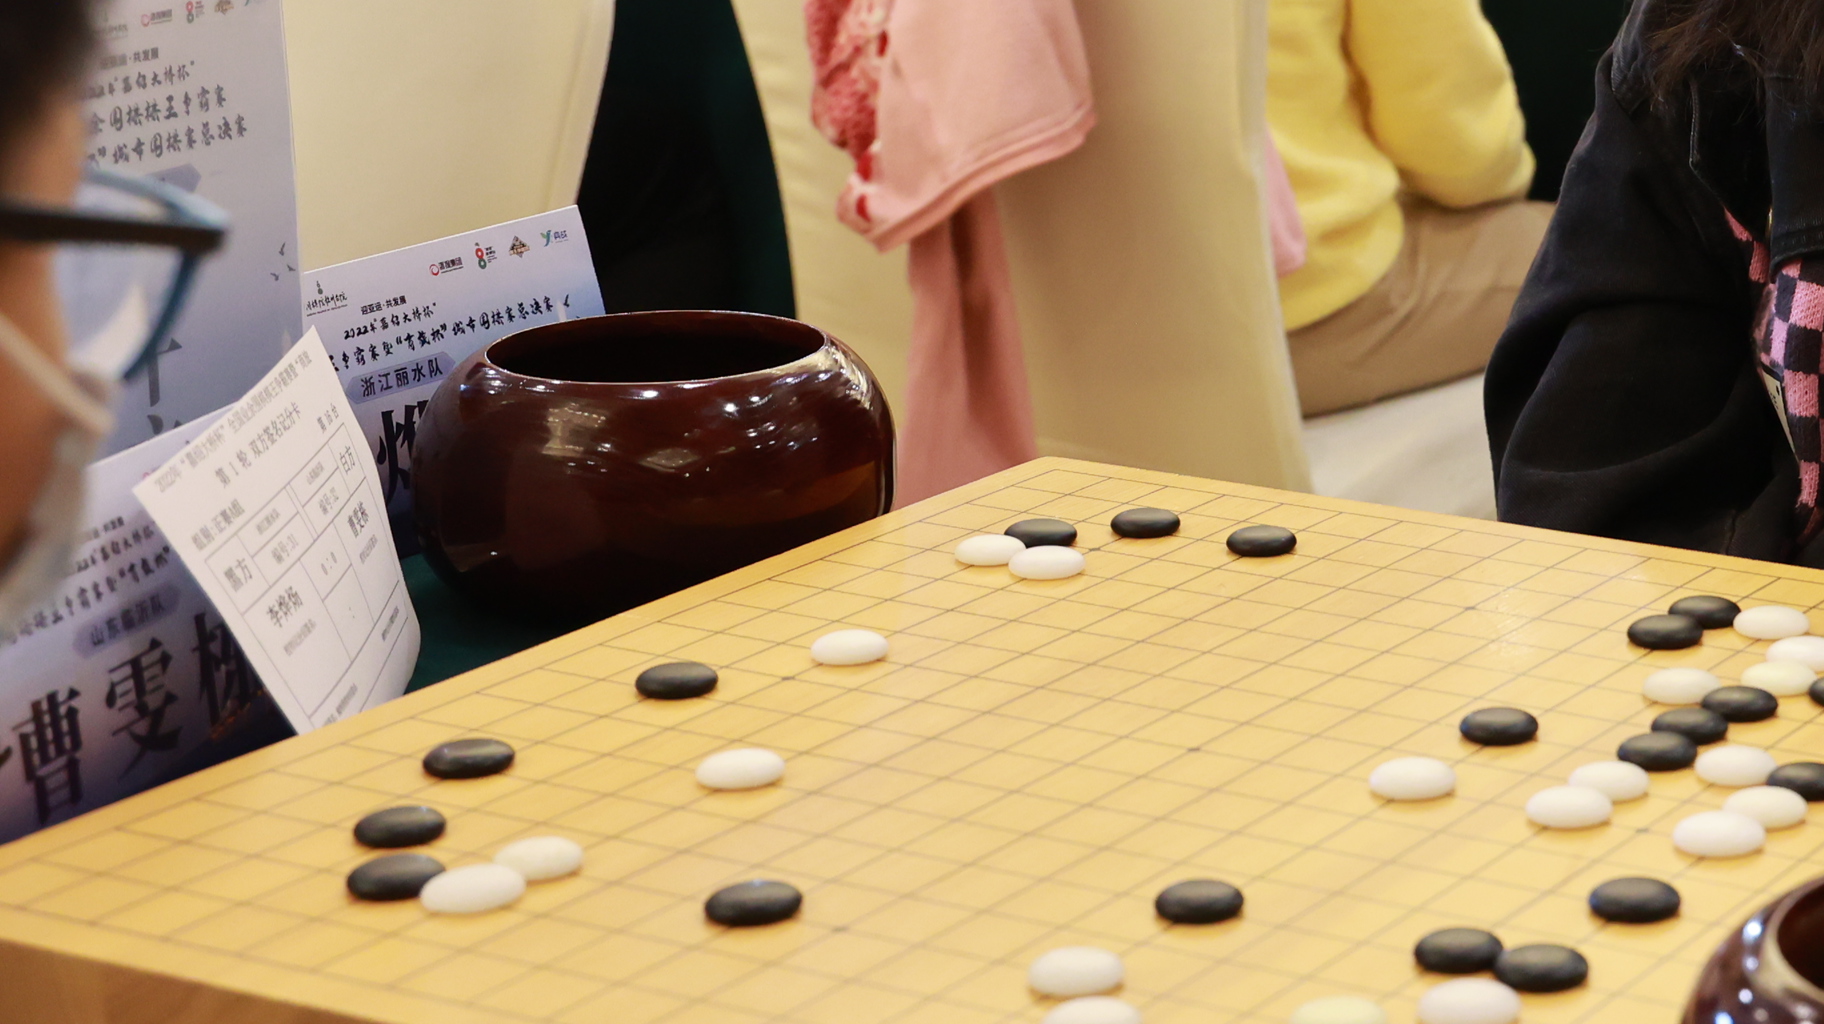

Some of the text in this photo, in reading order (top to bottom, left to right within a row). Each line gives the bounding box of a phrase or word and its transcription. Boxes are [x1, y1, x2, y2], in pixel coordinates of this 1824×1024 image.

[360, 357, 444, 398] 浙江丽水队
[339, 445, 356, 475] 白方
